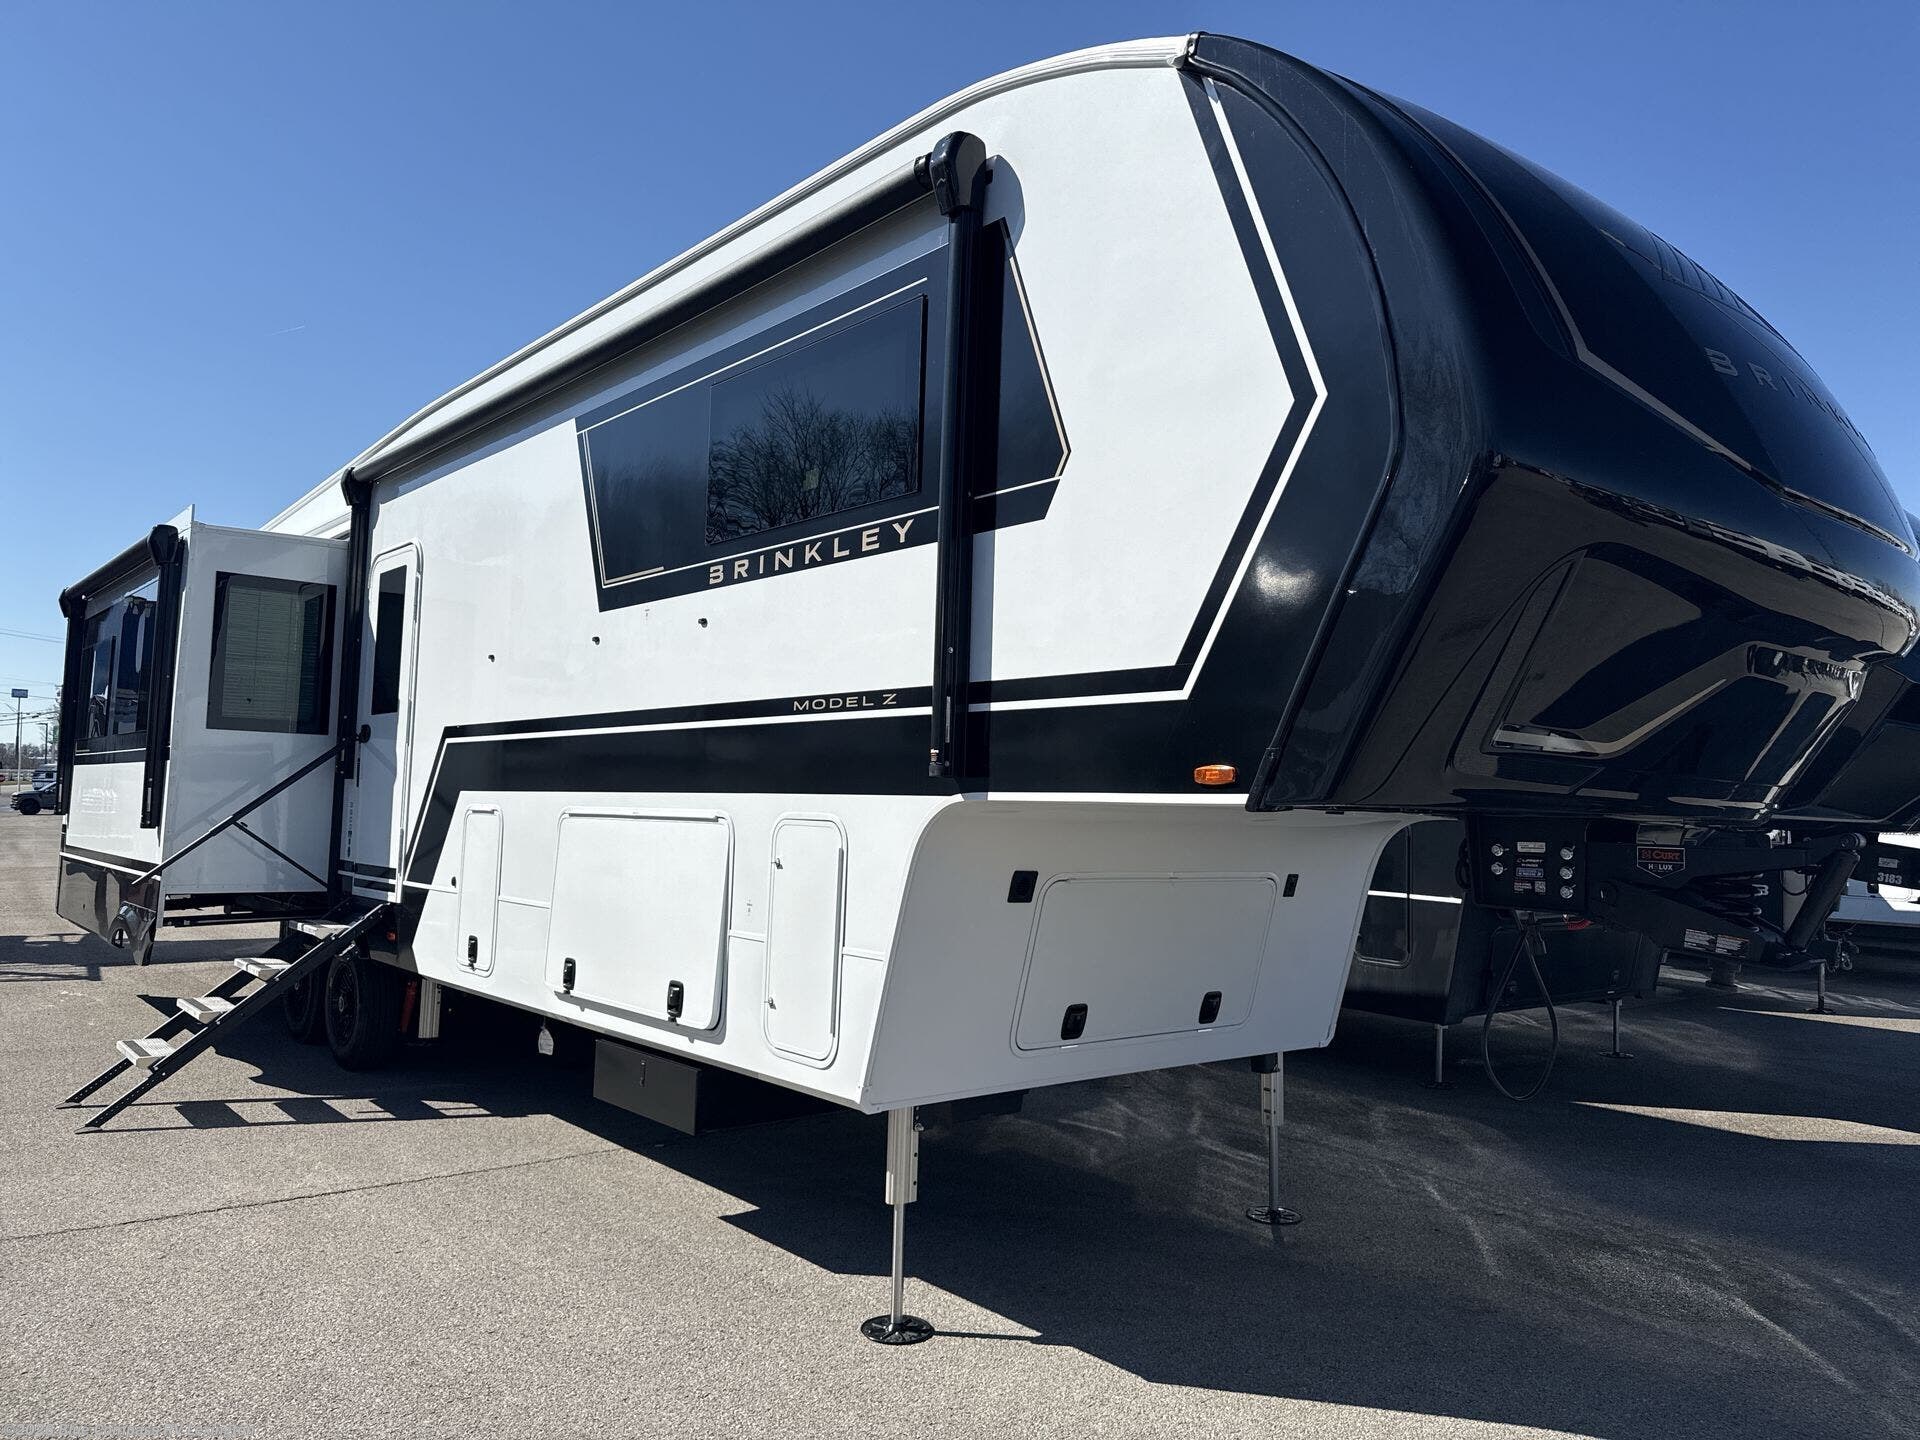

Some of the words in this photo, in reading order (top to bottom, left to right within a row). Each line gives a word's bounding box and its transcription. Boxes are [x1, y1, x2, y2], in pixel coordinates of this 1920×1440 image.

[709, 518, 914, 585] BRINKLEY
[793, 696, 874, 711] MODEL
[882, 693, 897, 705] Z
[1652, 850, 1680, 860] CURT
[1877, 872, 1902, 885] 3183
